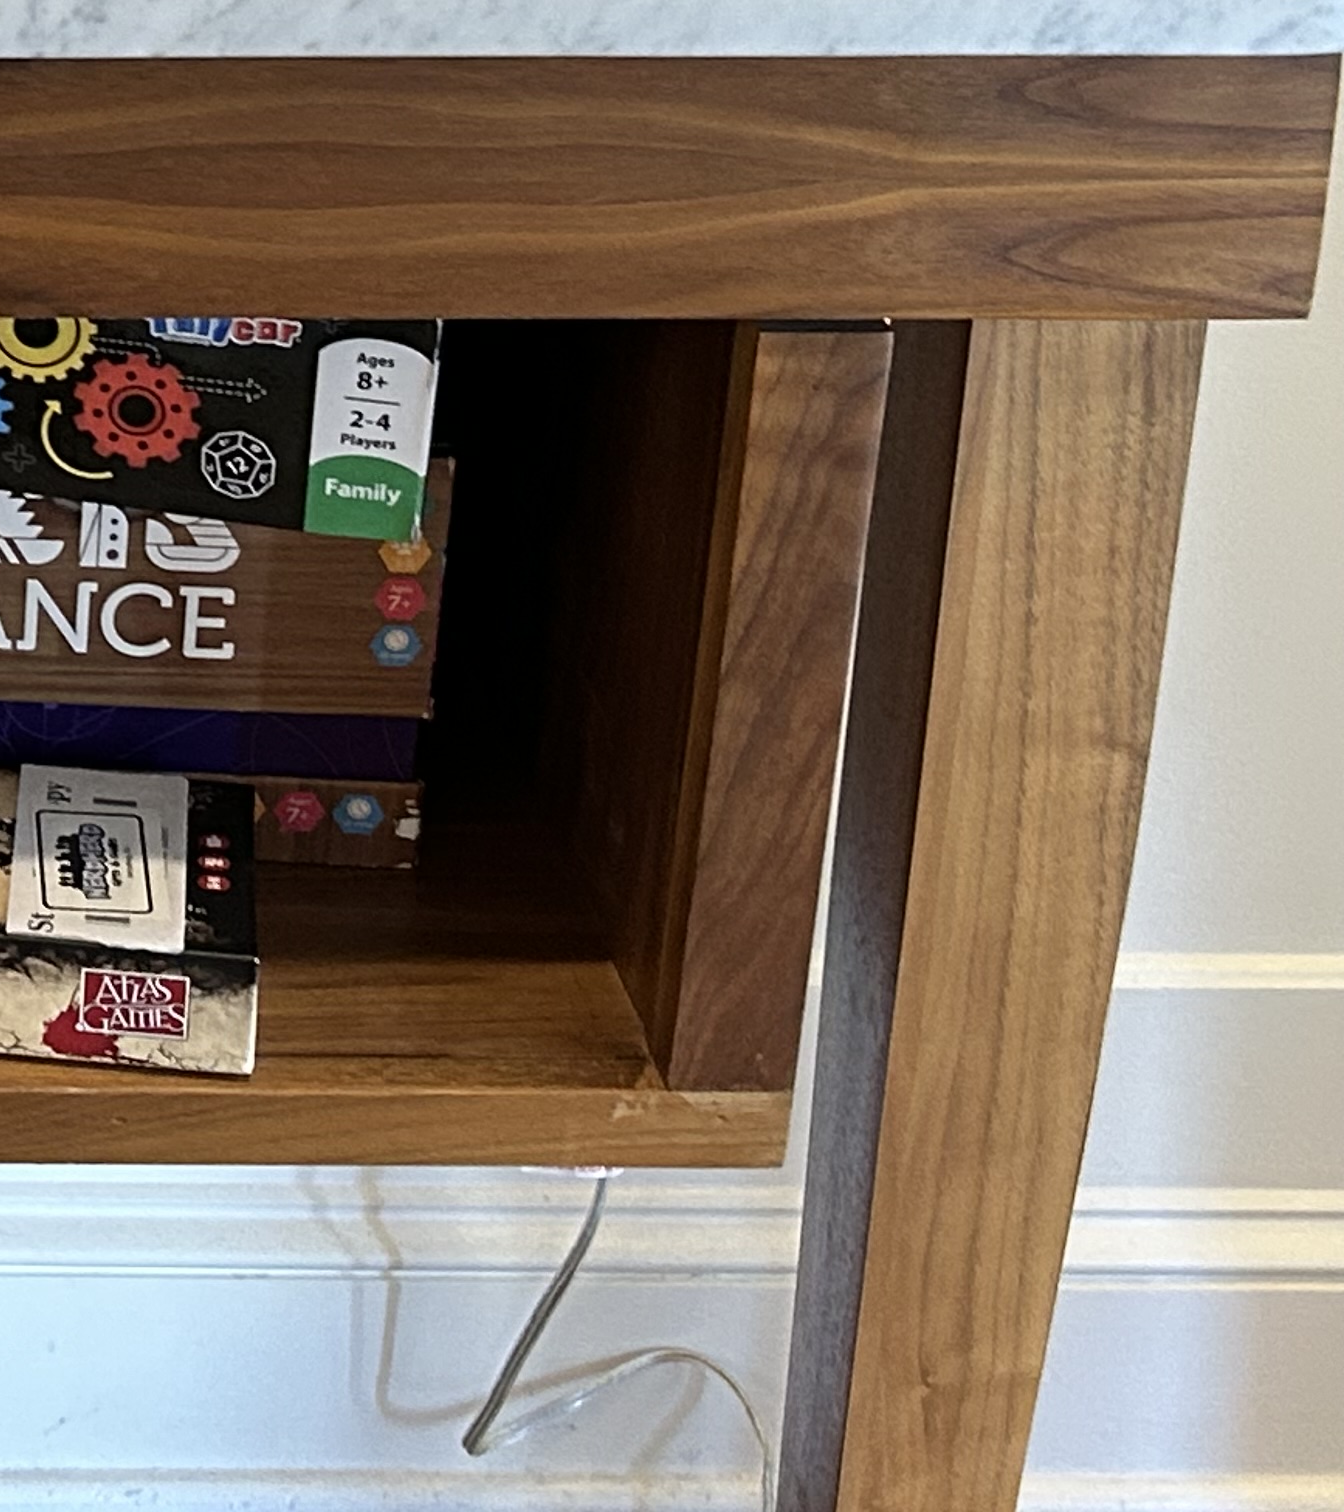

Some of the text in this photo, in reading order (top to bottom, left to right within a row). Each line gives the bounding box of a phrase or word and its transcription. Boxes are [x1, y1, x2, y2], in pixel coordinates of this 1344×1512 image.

[357, 352, 395, 369] Ages
[356, 371, 388, 391] 8+
[349, 410, 391, 431] 2-4
[340, 433, 396, 451] Players
[225, 456, 250, 475] 12
[325, 478, 401, 506] Family
[387, 594, 411, 611] 7+
[93, 973, 174, 1006] ATLAS
[82, 1002, 187, 1037] GAMES
